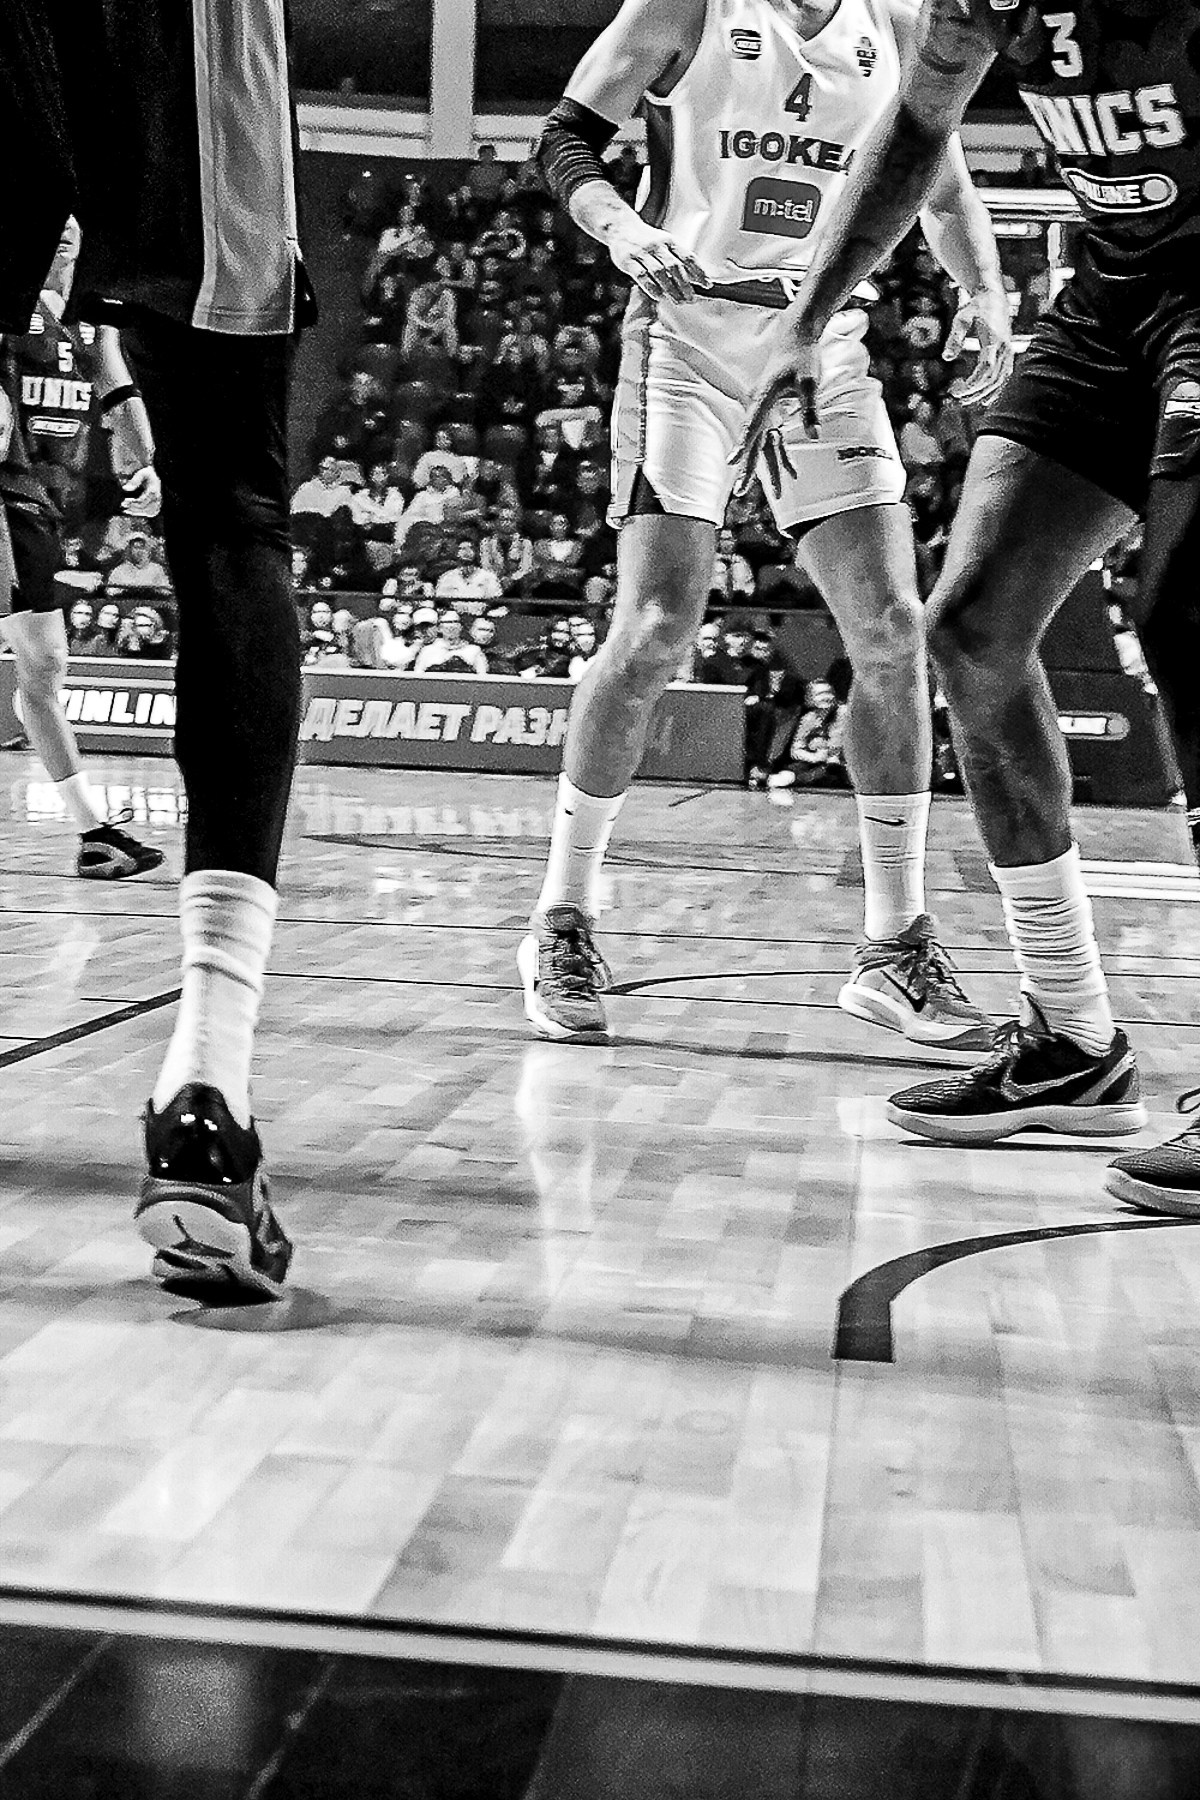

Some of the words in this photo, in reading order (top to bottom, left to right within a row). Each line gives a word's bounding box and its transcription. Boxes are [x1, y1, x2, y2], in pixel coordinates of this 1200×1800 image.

[1042, 12, 1084, 78] 3
[784, 72, 813, 122] 4
[57, 341, 74, 373] 5
[57, 688, 177, 726] INLIN
[299, 697, 472, 742] ДЕЛАЕТ
